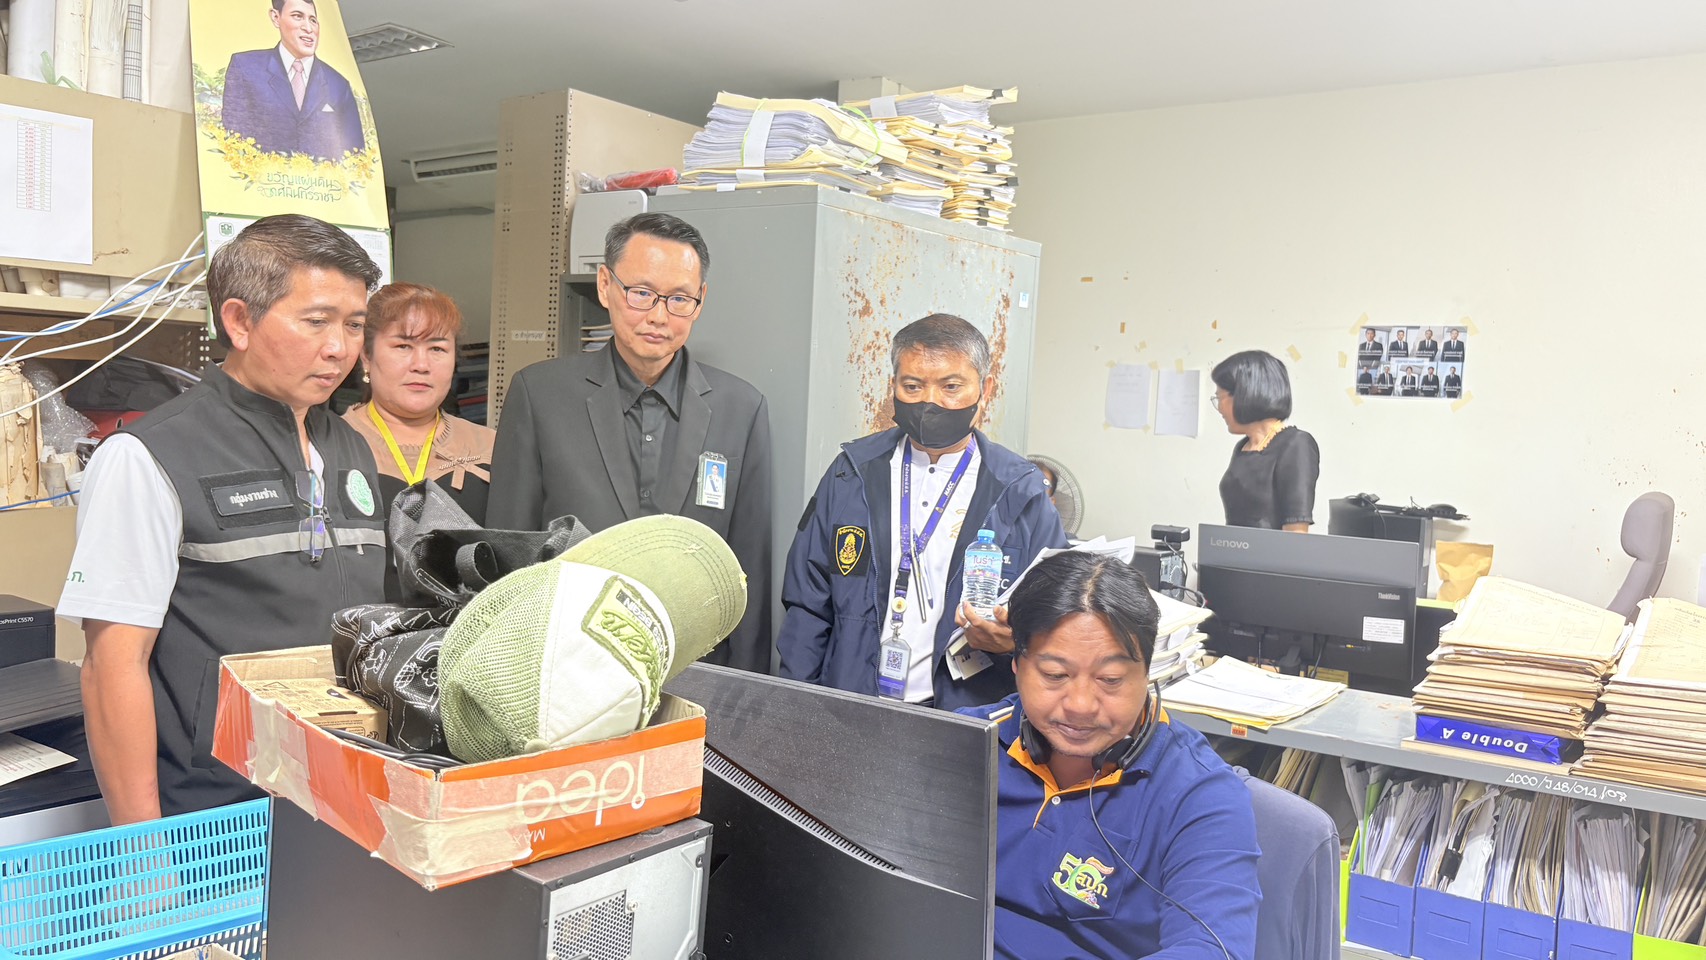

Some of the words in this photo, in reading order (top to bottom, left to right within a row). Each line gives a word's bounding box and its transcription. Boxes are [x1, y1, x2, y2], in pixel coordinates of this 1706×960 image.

[229, 487, 280, 507] กลุ่มงานช่าง
[1210, 536, 1249, 549] Lenovo
[1442, 727, 1455, 739] A
[1461, 731, 1529, 753] Double
[512, 827, 546, 847] MAX
